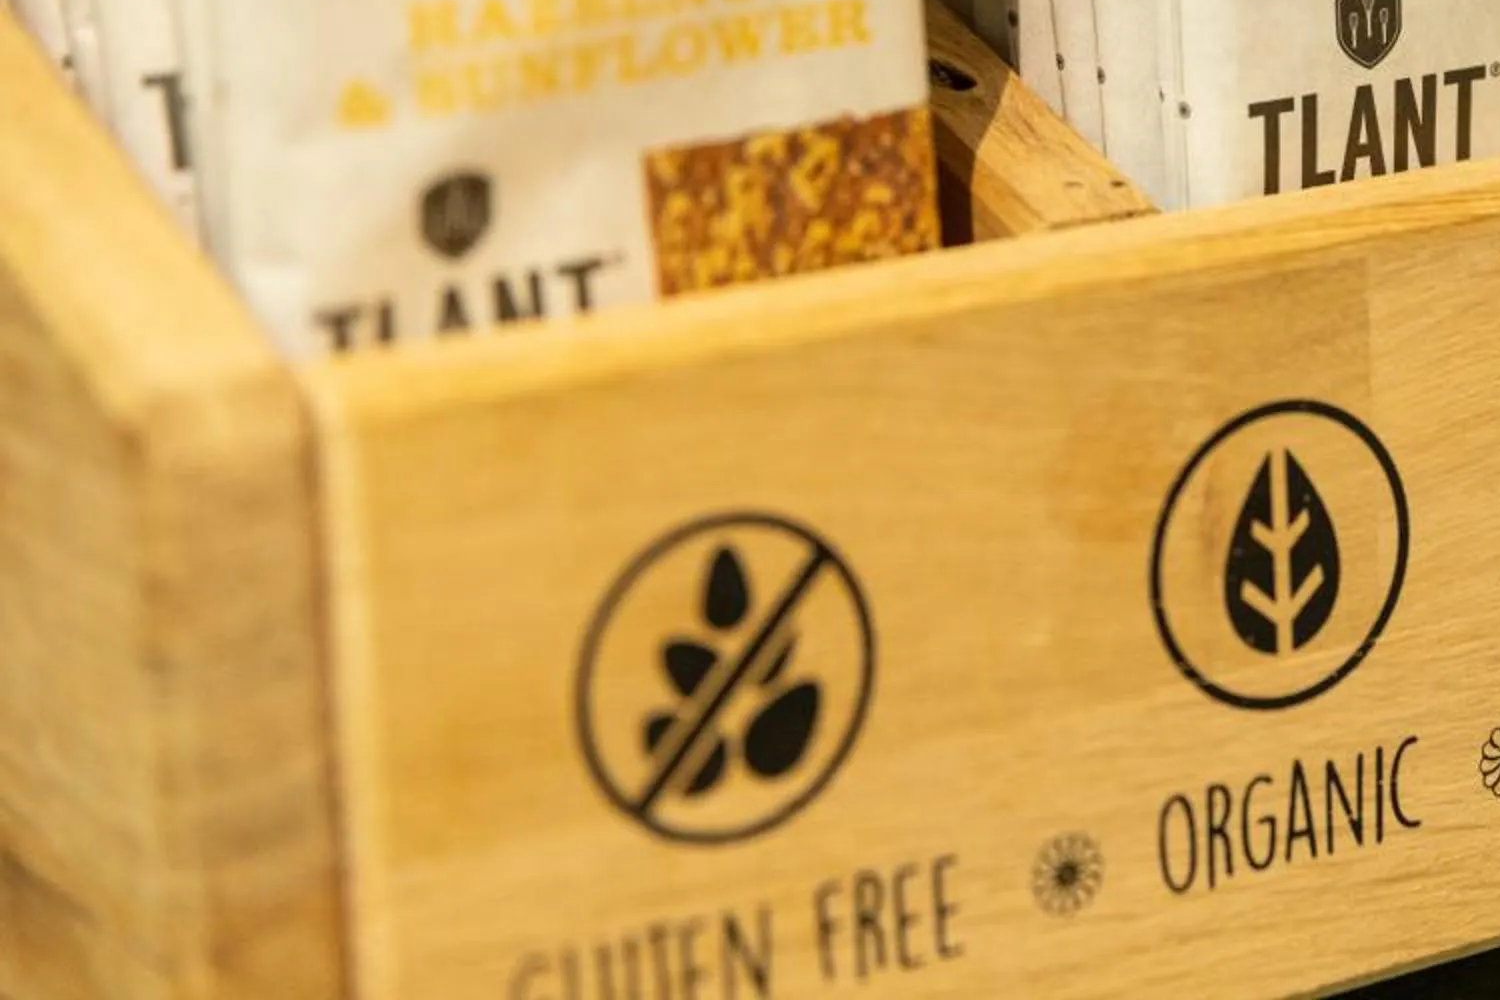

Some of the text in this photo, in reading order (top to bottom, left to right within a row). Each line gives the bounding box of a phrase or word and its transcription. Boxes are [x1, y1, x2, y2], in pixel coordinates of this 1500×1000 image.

[1248, 64, 1487, 196] TLANT
[1158, 735, 1423, 896] ORGANIC
[813, 853, 965, 981] FREE
